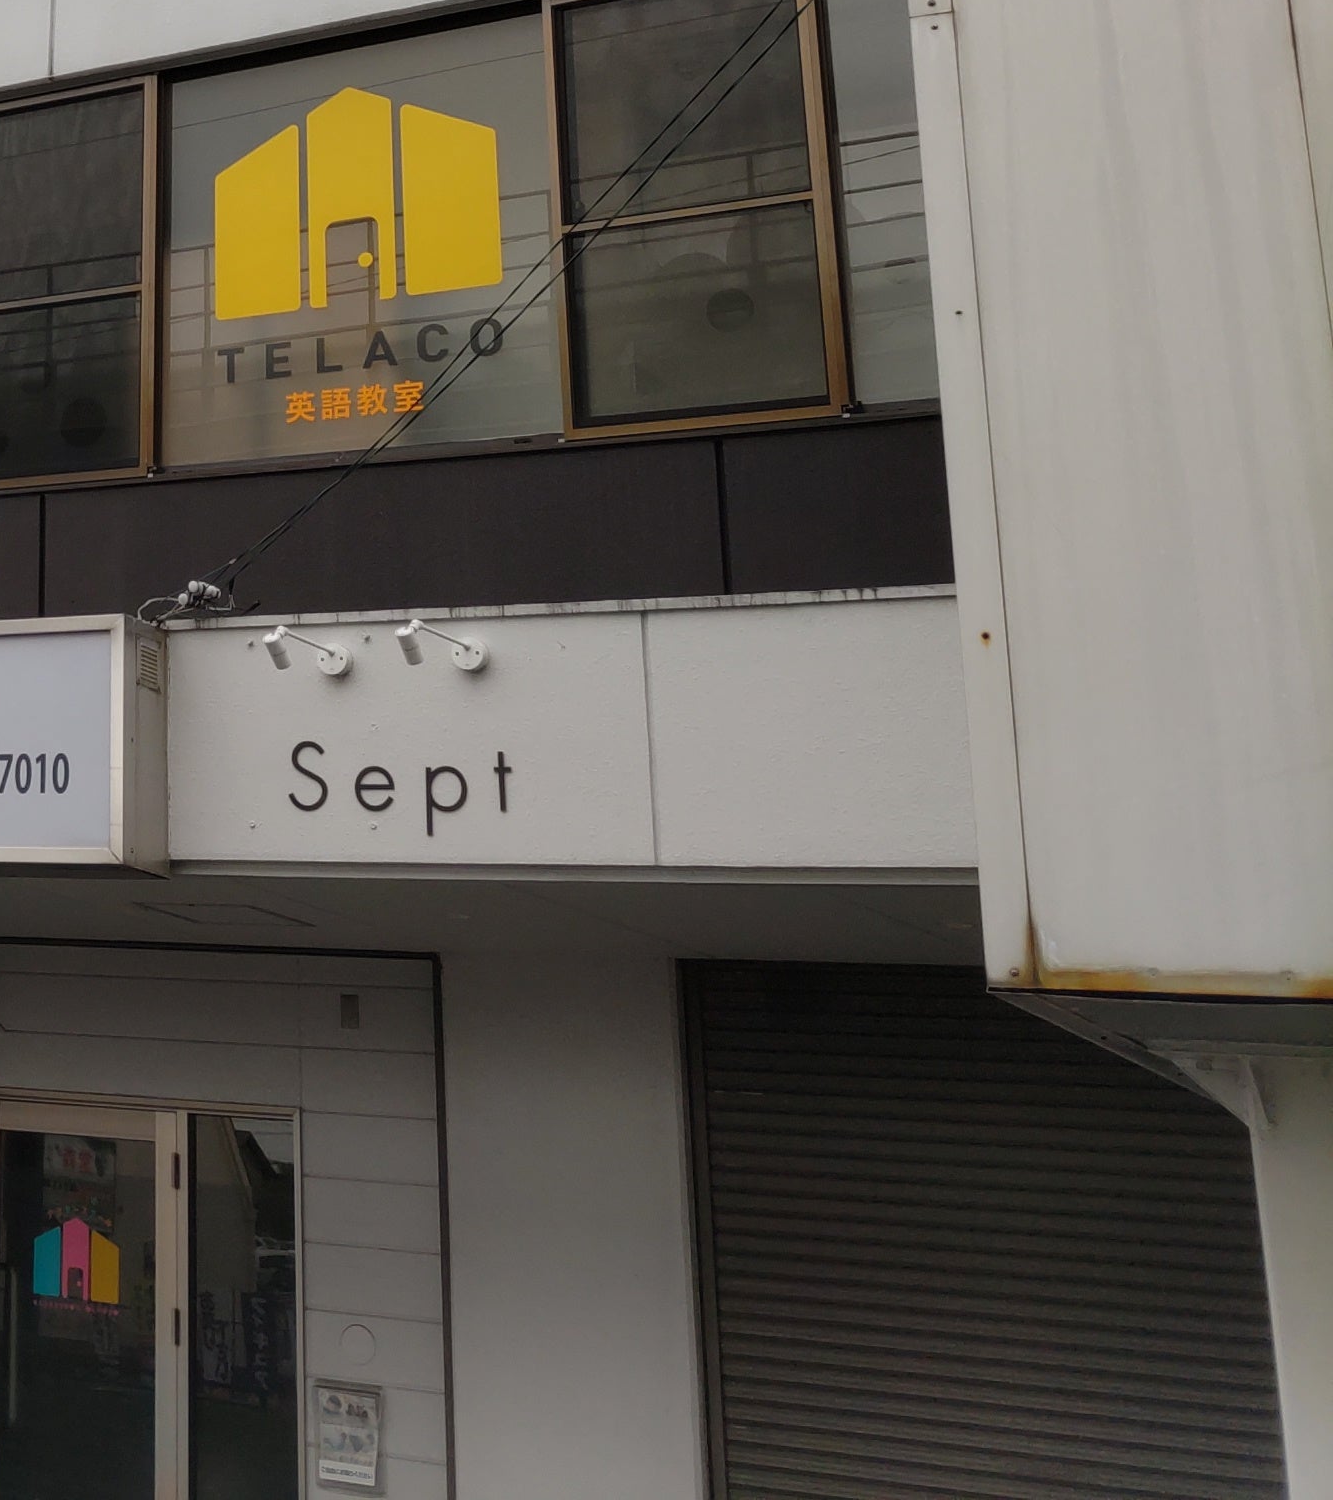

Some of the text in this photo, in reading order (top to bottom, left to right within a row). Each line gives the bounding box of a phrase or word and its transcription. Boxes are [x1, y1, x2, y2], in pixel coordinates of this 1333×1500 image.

[217, 318, 505, 384] TELACO
[284, 379, 426, 426] 英語教室
[287, 739, 513, 837] Sept
